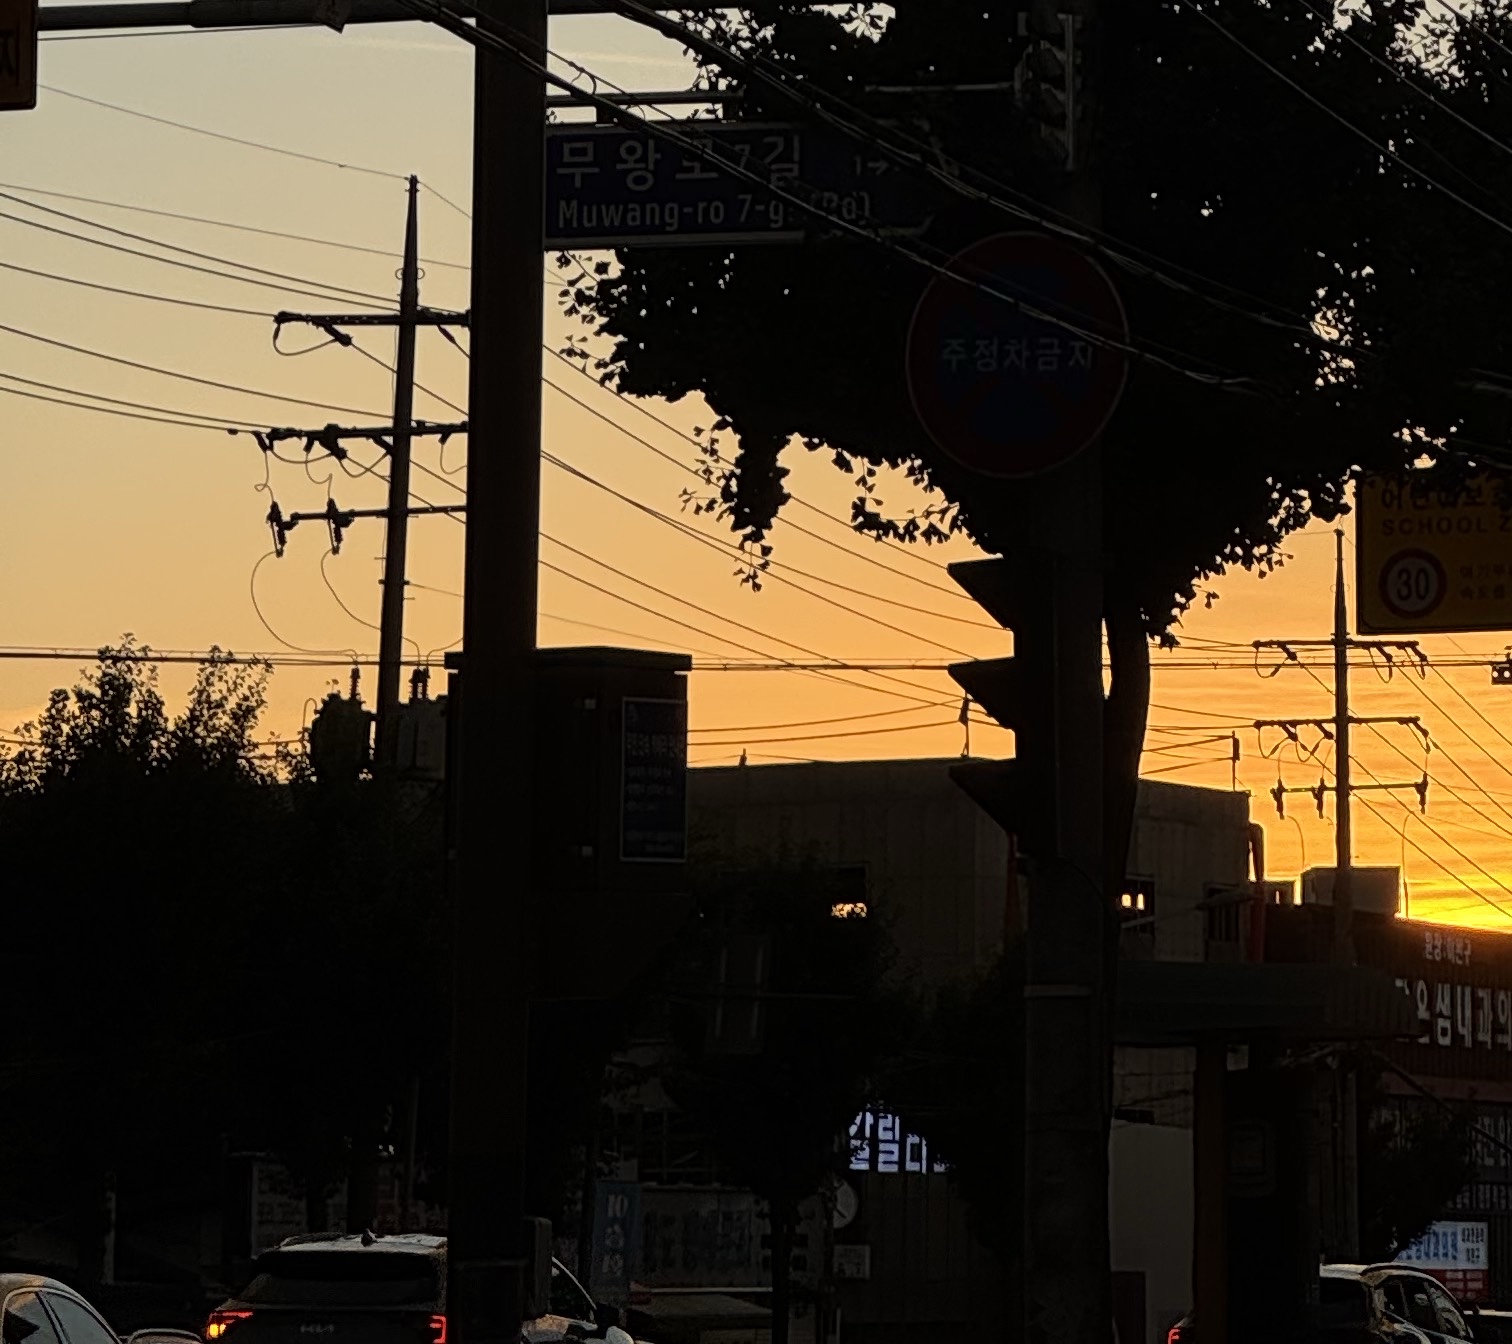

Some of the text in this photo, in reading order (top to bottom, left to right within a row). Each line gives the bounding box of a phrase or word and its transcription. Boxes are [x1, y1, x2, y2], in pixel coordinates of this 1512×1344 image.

[558, 195, 725, 231] Muwang-ro
[736, 193, 795, 229] 7-g
[942, 336, 1095, 373] 주정차금지
[1381, 514, 1489, 538] SCHOOL
[1396, 567, 1430, 602] 30
